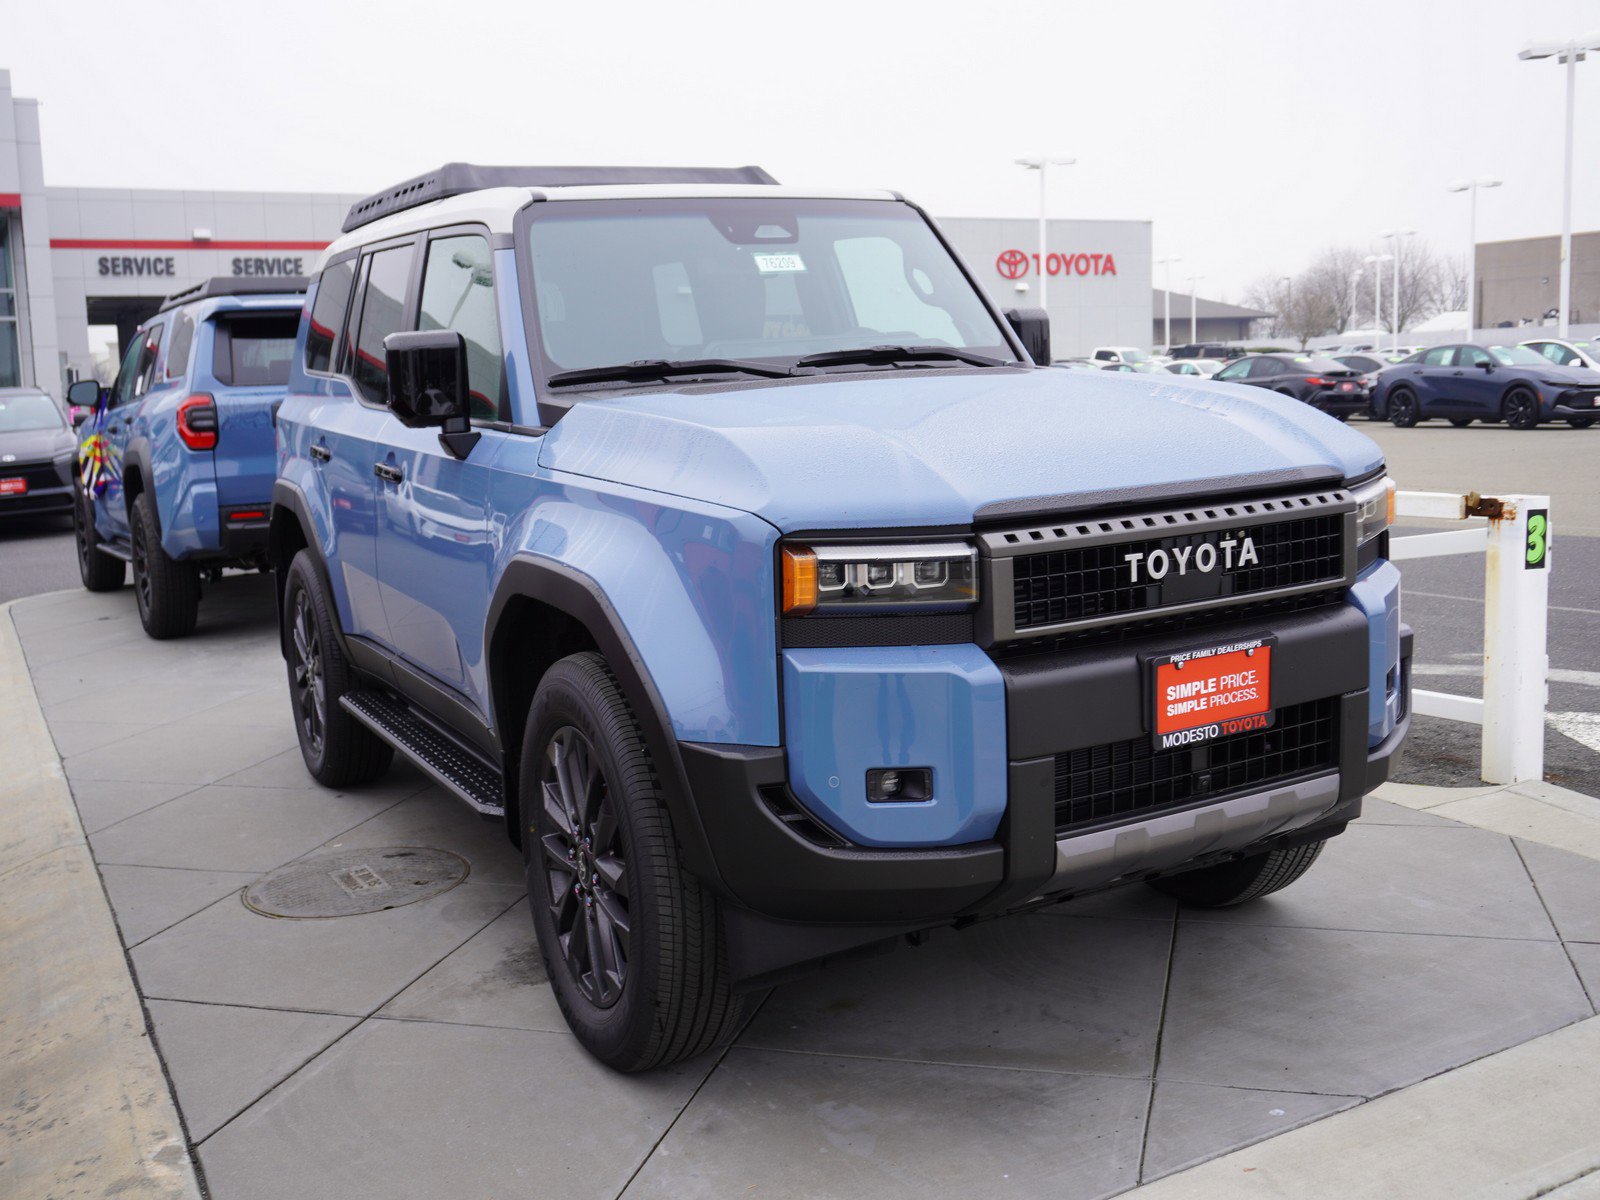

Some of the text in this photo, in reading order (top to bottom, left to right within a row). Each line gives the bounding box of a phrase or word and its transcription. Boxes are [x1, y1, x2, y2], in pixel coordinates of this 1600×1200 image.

[98, 256, 175, 276] SERVICE
[232, 257, 304, 276] SERVICE
[1031, 252, 1118, 276] TOYOTA
[1526, 514, 1548, 565] 3
[1124, 537, 1259, 583] TOYOTA
[1170, 639, 1262, 664] PRICE FAMILY DEALERSHIPS
[1166, 669, 1259, 701] SIMPLE PRICE.
[1166, 687, 1259, 717] SIMPLE PROCESS.
[1162, 714, 1267, 749] MODESTO TOYOTA
